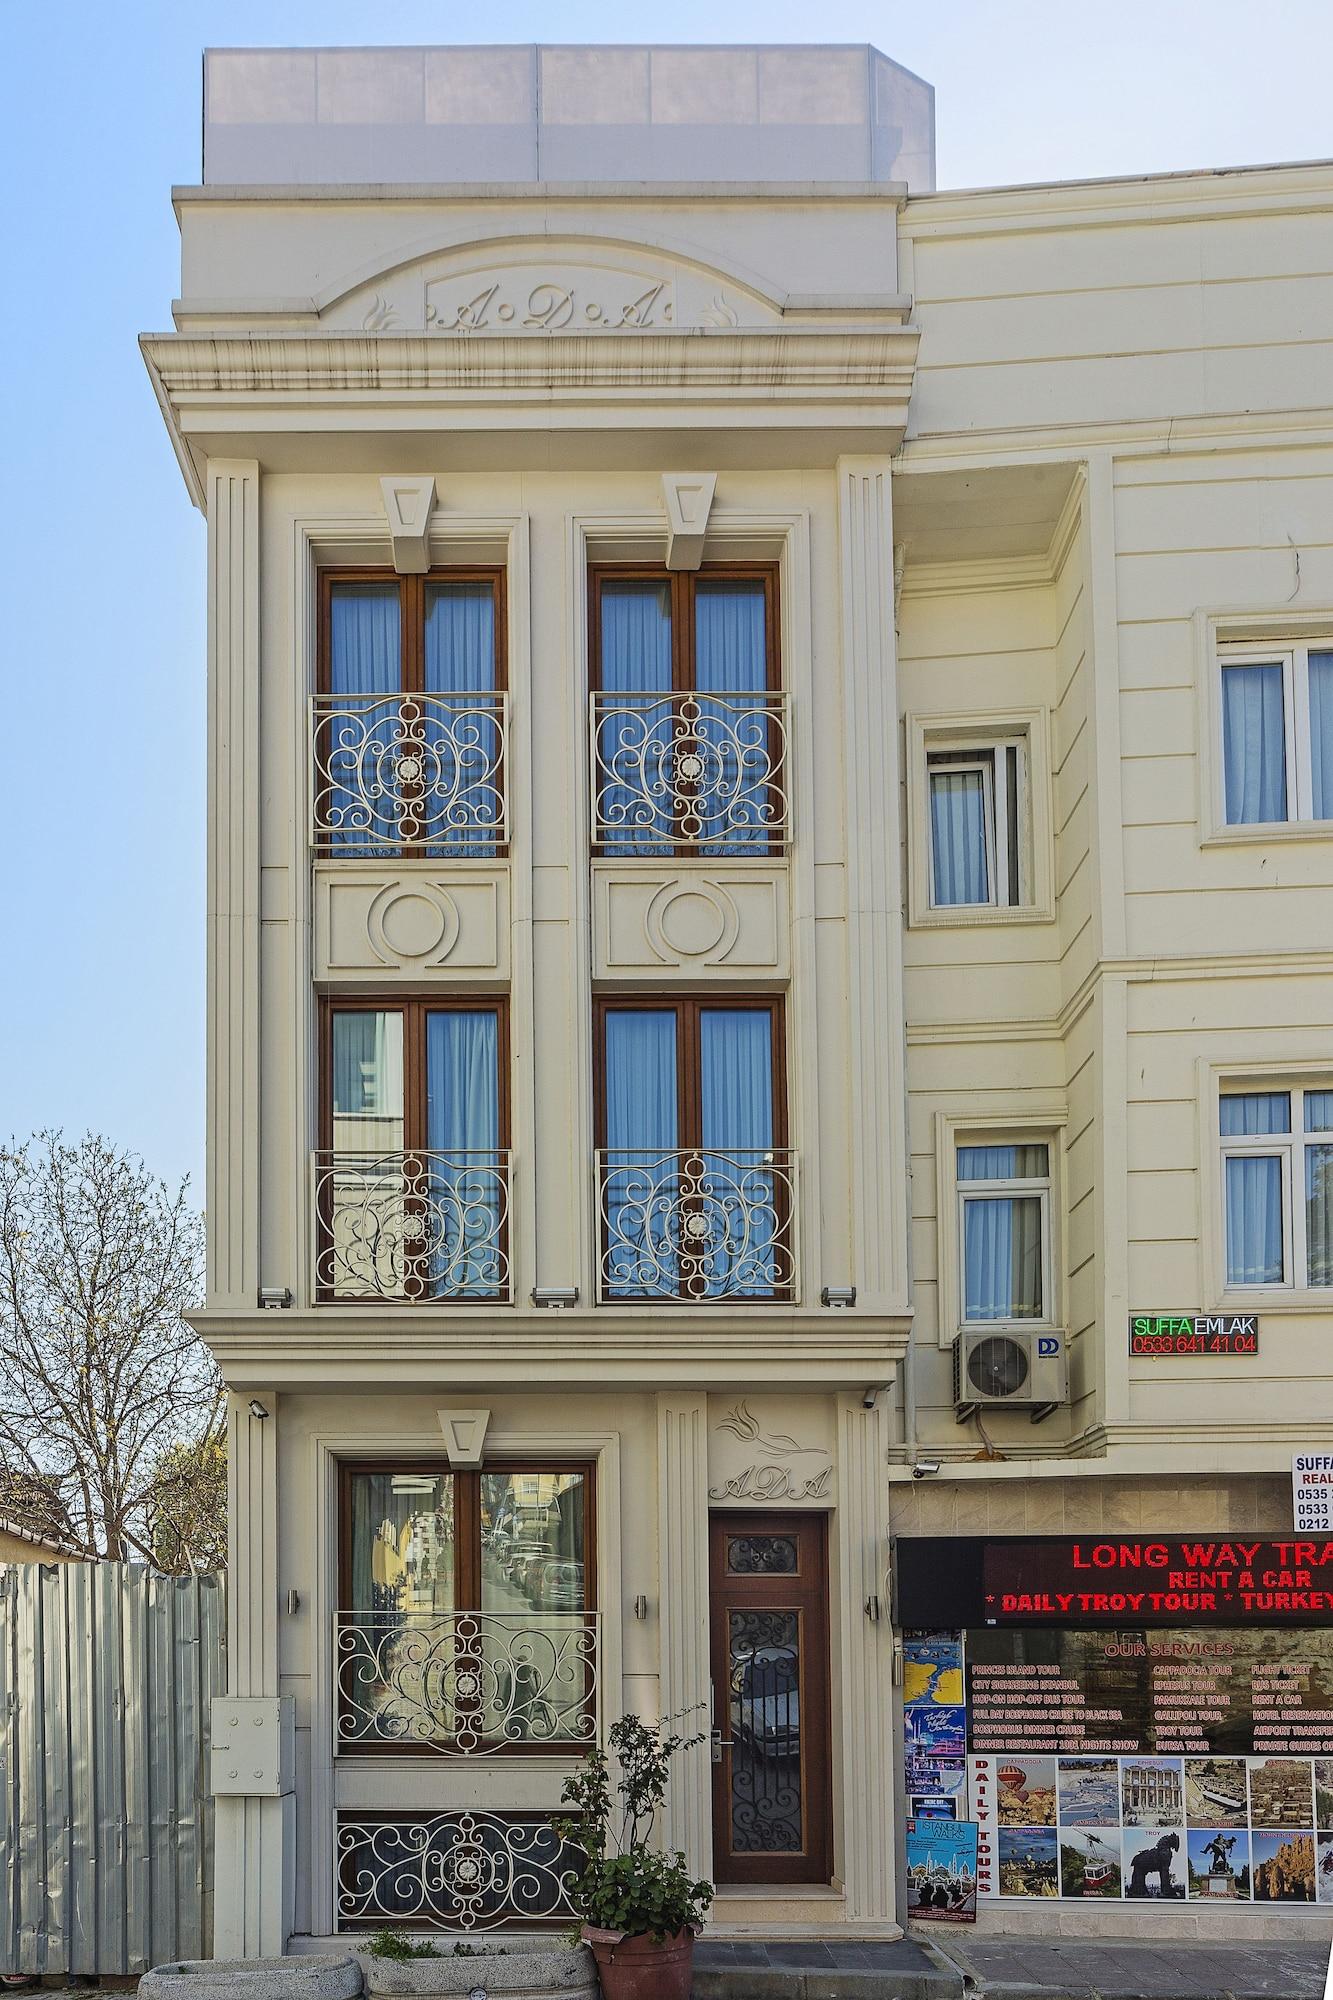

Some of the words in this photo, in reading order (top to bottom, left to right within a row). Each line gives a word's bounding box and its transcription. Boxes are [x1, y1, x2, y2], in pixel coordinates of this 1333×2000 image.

[1134, 1318, 1193, 1336] SUFFA
[1194, 1317, 1255, 1336] EMLAK
[1133, 1336, 1173, 1353] 0533
[1176, 1336, 1205, 1353] 641
[1210, 1336, 1229, 1353] 41
[1235, 1336, 1256, 1353] 04
[709, 1465, 833, 1500] ADA
[1298, 1488, 1328, 1500] 0535
[1299, 1503, 1328, 1515] 0533
[1299, 1518, 1329, 1530] 0212
[1073, 1545, 1169, 1568] LONG
[1181, 1543, 1262, 1567] WAY
[1169, 1571, 1233, 1589] RENT
[1238, 1571, 1254, 1588] A
[1262, 1570, 1312, 1588] CAR
[1001, 1594, 1074, 1612] DAILY
[1078, 1593, 1145, 1611] TROY
[1149, 1592, 1216, 1610] TOUR
[1104, 1643, 1147, 1657] OUR
[1150, 1642, 1235, 1657] SERVICES
[972, 1665, 1006, 1675] PRINCES
[1006, 1665, 1036, 1675] ISLAND
[1037, 1665, 1060, 1675] TOUR
[1153, 1665, 1207, 1676] CAPPADOCIA
[1208, 1665, 1233, 1676] TOUR
[1281, 1664, 1312, 1675] TICKET
[972, 1680, 991, 1690] CITY
[1040, 1680, 1080, 1690] ISTANBUL
[1153, 1680, 1192, 1691] EPHESUS
[1193, 1680, 1216, 1691] TOUR
[1251, 1680, 1269, 1690] BUS
[1269, 1680, 1299, 1690] TICKET
[972, 1694, 1006, 1705] HOP-ON
[1006, 1694, 1043, 1705] HOP-OFF
[1044, 1694, 1061, 1705] BUS
[1061, 1694, 1085, 1705] TOUR
[1153, 1695, 1205, 1705] PAMUKKALE
[1206, 1695, 1231, 1705] TOUR
[1252, 1694, 1275, 1705] RENT
[1275, 1694, 1283, 1705] A
[1284, 1694, 1302, 1705] CAR
[972, 1709, 990, 1720] FULL
[989, 1709, 1005, 1720] DAY
[1005, 1709, 1048, 1720] BOSPHORUS
[1048, 1709, 1074, 1720] CRUISE
[1074, 1709, 1085, 1720] TO
[1085, 1709, 1109, 1720] BLACK
[1109, 1709, 1123, 1720] SEA
[1154, 1710, 1197, 1721] GALLIPOLI
[1197, 1710, 1222, 1721] TOUR
[1252, 1710, 1280, 1721] HOTEL
[1280, 1710, 1333, 1721] RESERVATIO
[972, 1725, 1023, 1735] BOSPHORUS
[1023, 1725, 1055, 1735] DINNER
[1056, 1725, 1086, 1735] CRUISE
[1154, 1725, 1179, 1736] TROY
[1179, 1725, 1203, 1736] TOUR
[1253, 1725, 1291, 1736] AIRPORT
[972, 1739, 1005, 1750] DINNER
[1005, 1739, 1058, 1750] RESTAURANT
[1058, 1739, 1079, 1750] 1001
[1079, 1739, 1112, 1750] NIGHTS
[1112, 1739, 1139, 1750] SHOW
[1156, 1740, 1185, 1751] BURSA
[1185, 1740, 1210, 1751] TOUR
[1253, 1740, 1288, 1751] PRIVATE
[1289, 1740, 1321, 1751] GUIDES
[975, 1760, 990, 1821] DAILY
[977, 1831, 992, 1893] TOURS
